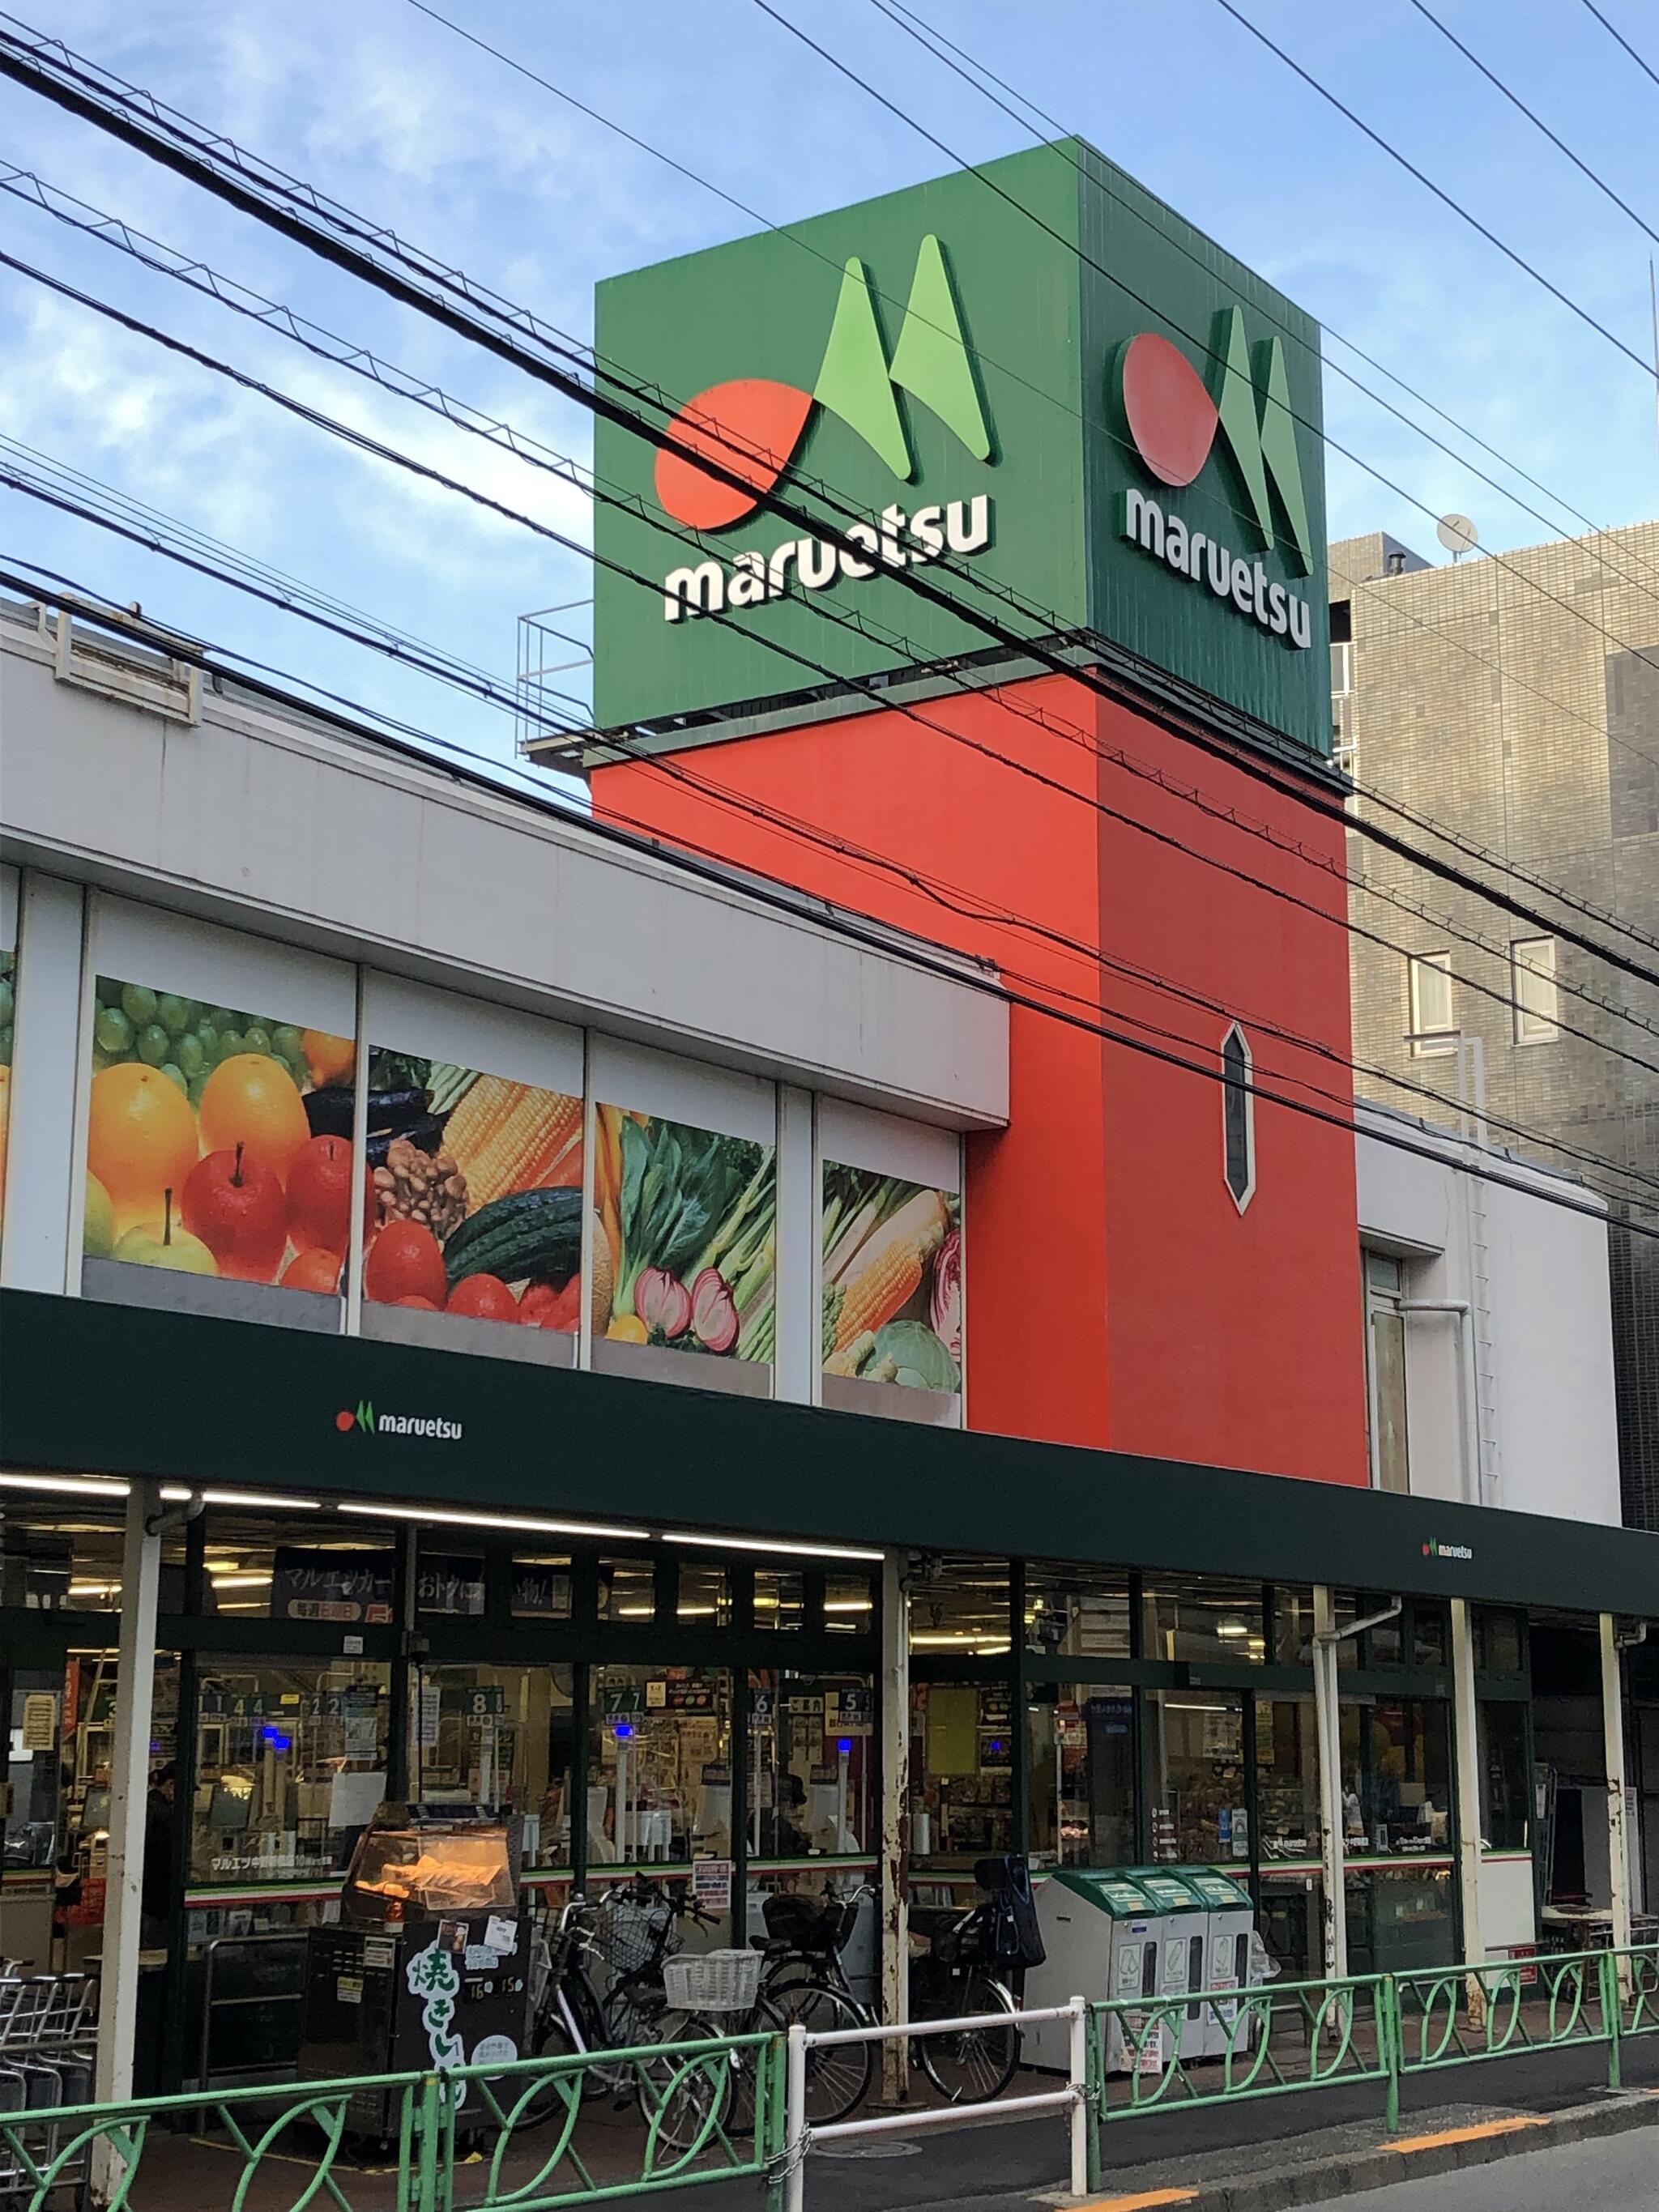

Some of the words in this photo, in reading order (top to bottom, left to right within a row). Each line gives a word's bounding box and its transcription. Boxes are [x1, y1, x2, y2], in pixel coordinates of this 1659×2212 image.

[664, 495, 988, 621] maruetsu
[1127, 489, 1311, 648] maruetsu
[378, 1414, 462, 1440] maruetsu
[1439, 1545, 1472, 1559] maruetsu
[472, 1693, 487, 1714] 8
[756, 1695, 768, 1713] 6
[845, 1694, 857, 1711] 5
[411, 1947, 463, 2103] 焼きい
